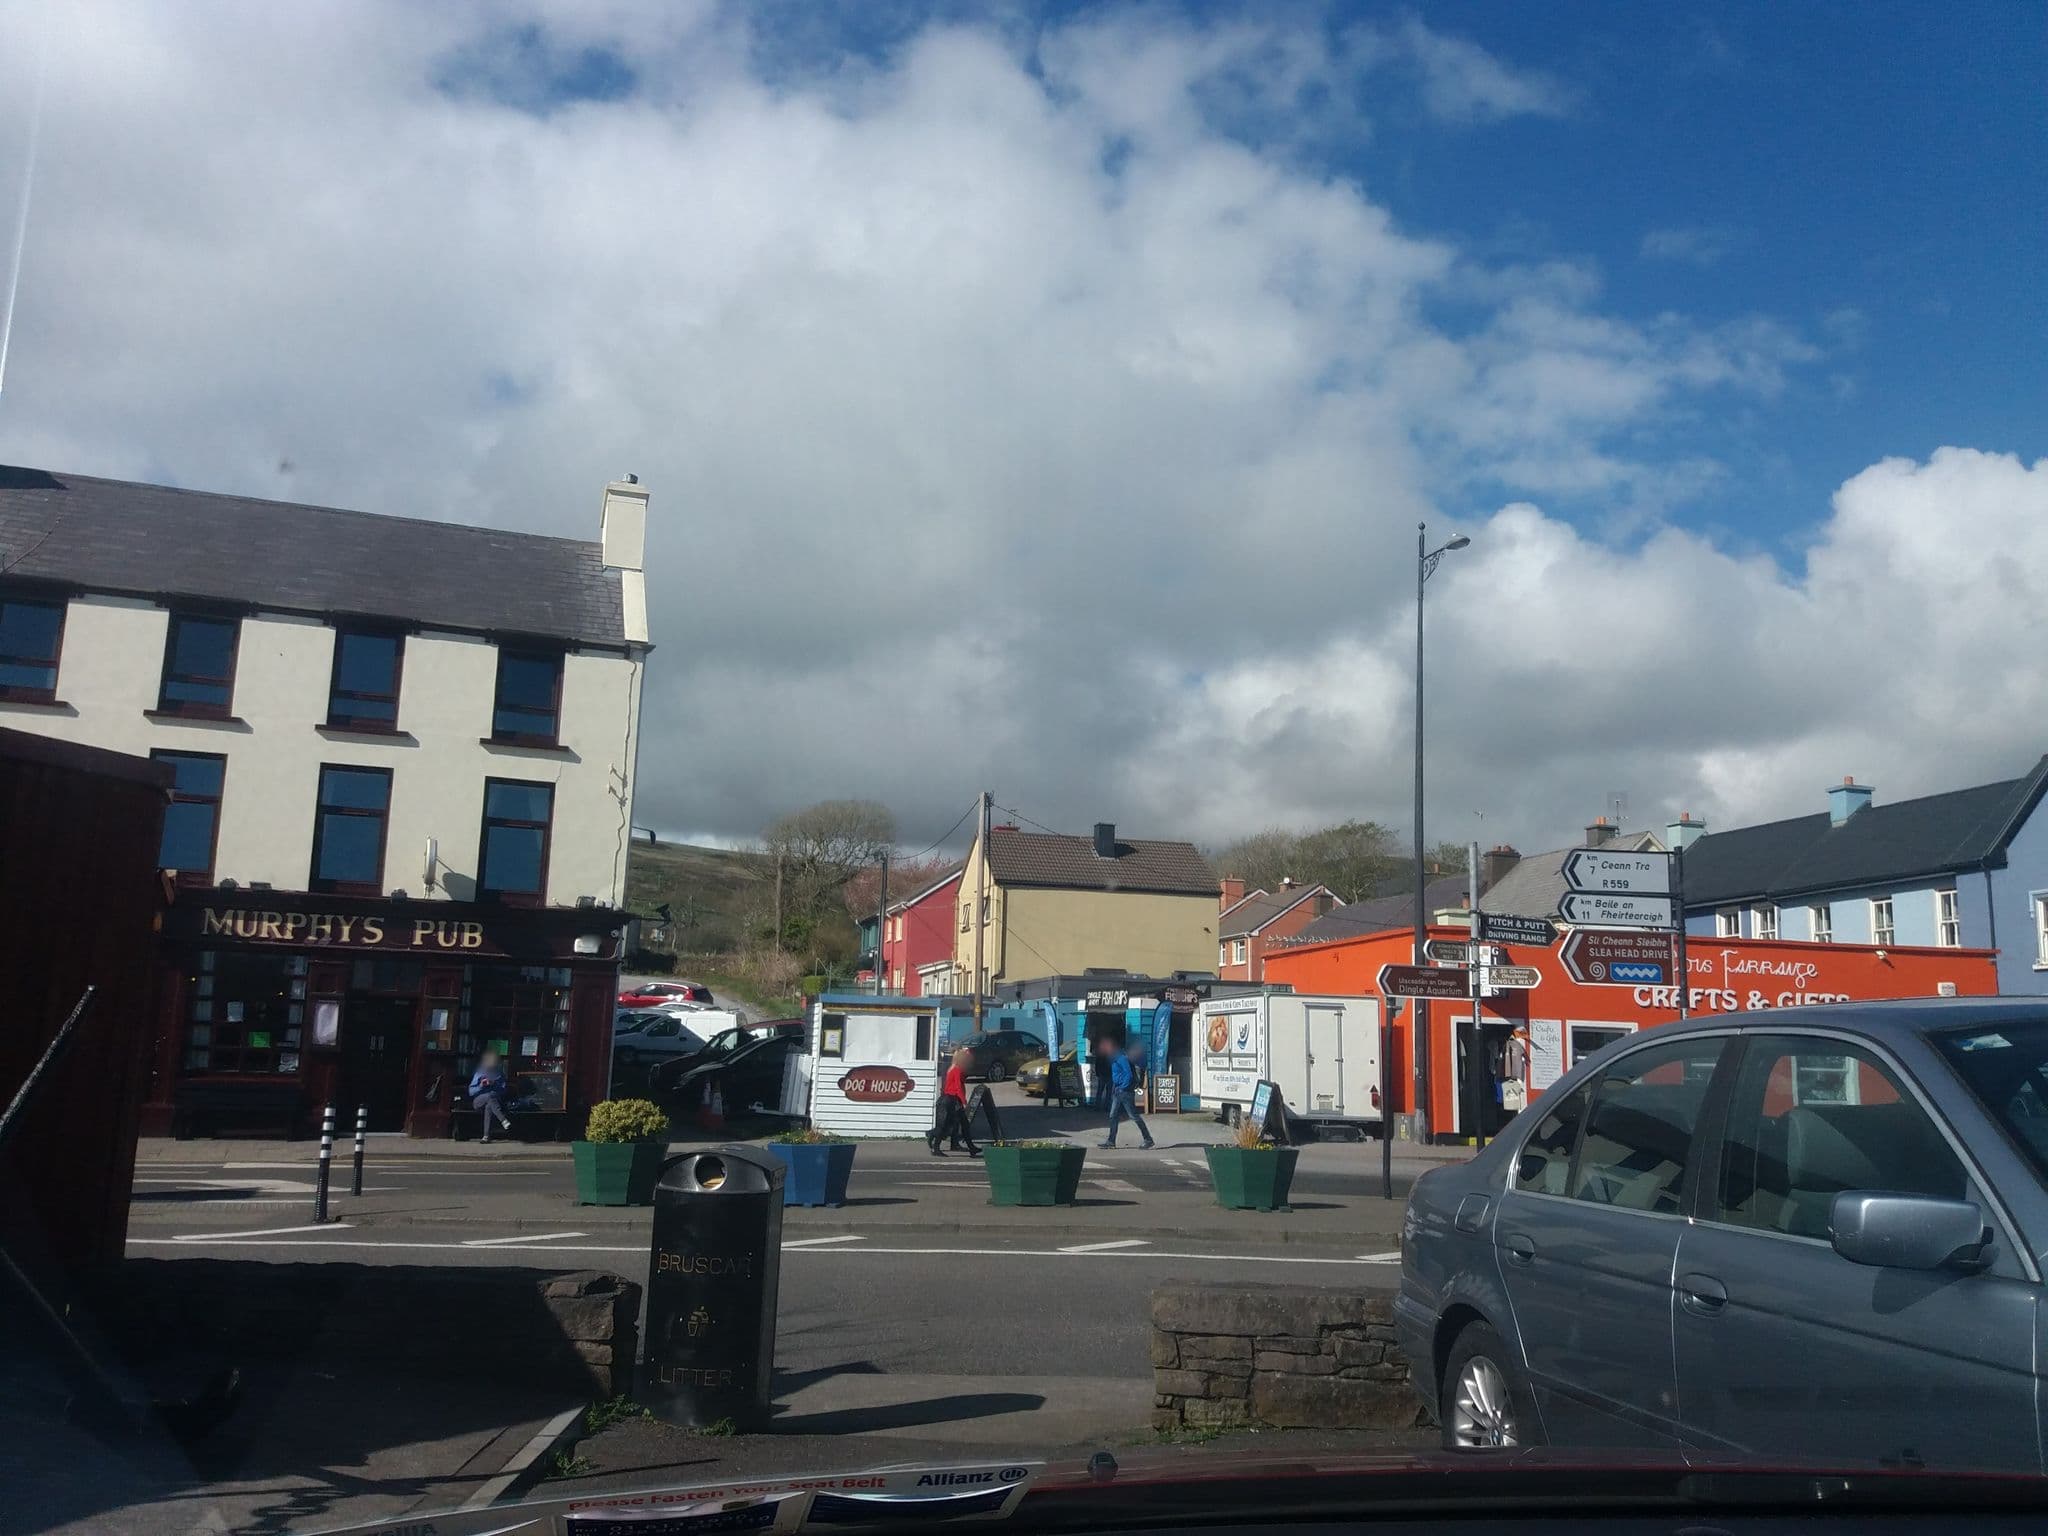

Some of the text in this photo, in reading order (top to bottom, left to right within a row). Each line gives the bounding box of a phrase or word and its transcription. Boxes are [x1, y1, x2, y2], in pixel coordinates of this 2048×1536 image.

[1586, 853, 1598, 861] km
[1590, 866, 1596, 875] 7
[1601, 861, 1631, 871] Ceann
[1595, 899, 1633, 909] Baile an
[1582, 911, 1590, 920] 11
[1488, 917, 1547, 930] PITCH & PUTT
[411, 919, 484, 948] PUB
[1488, 931, 1547, 943] DRIVING RANGE
[1589, 947, 1669, 959] SLEA HEAD DRIVE
[1399, 984, 1463, 996] Dingle Aquarium
[1746, 990, 1770, 1011] &
[845, 1079, 907, 1093] DOG HOUSE
[1158, 1088, 1175, 1096] FRESH
[1159, 1095, 1175, 1104] COD
[660, 1364, 733, 1387] LITTER
[569, 1471, 993, 1511] Please Fasten Your Seat Belt Allianz
